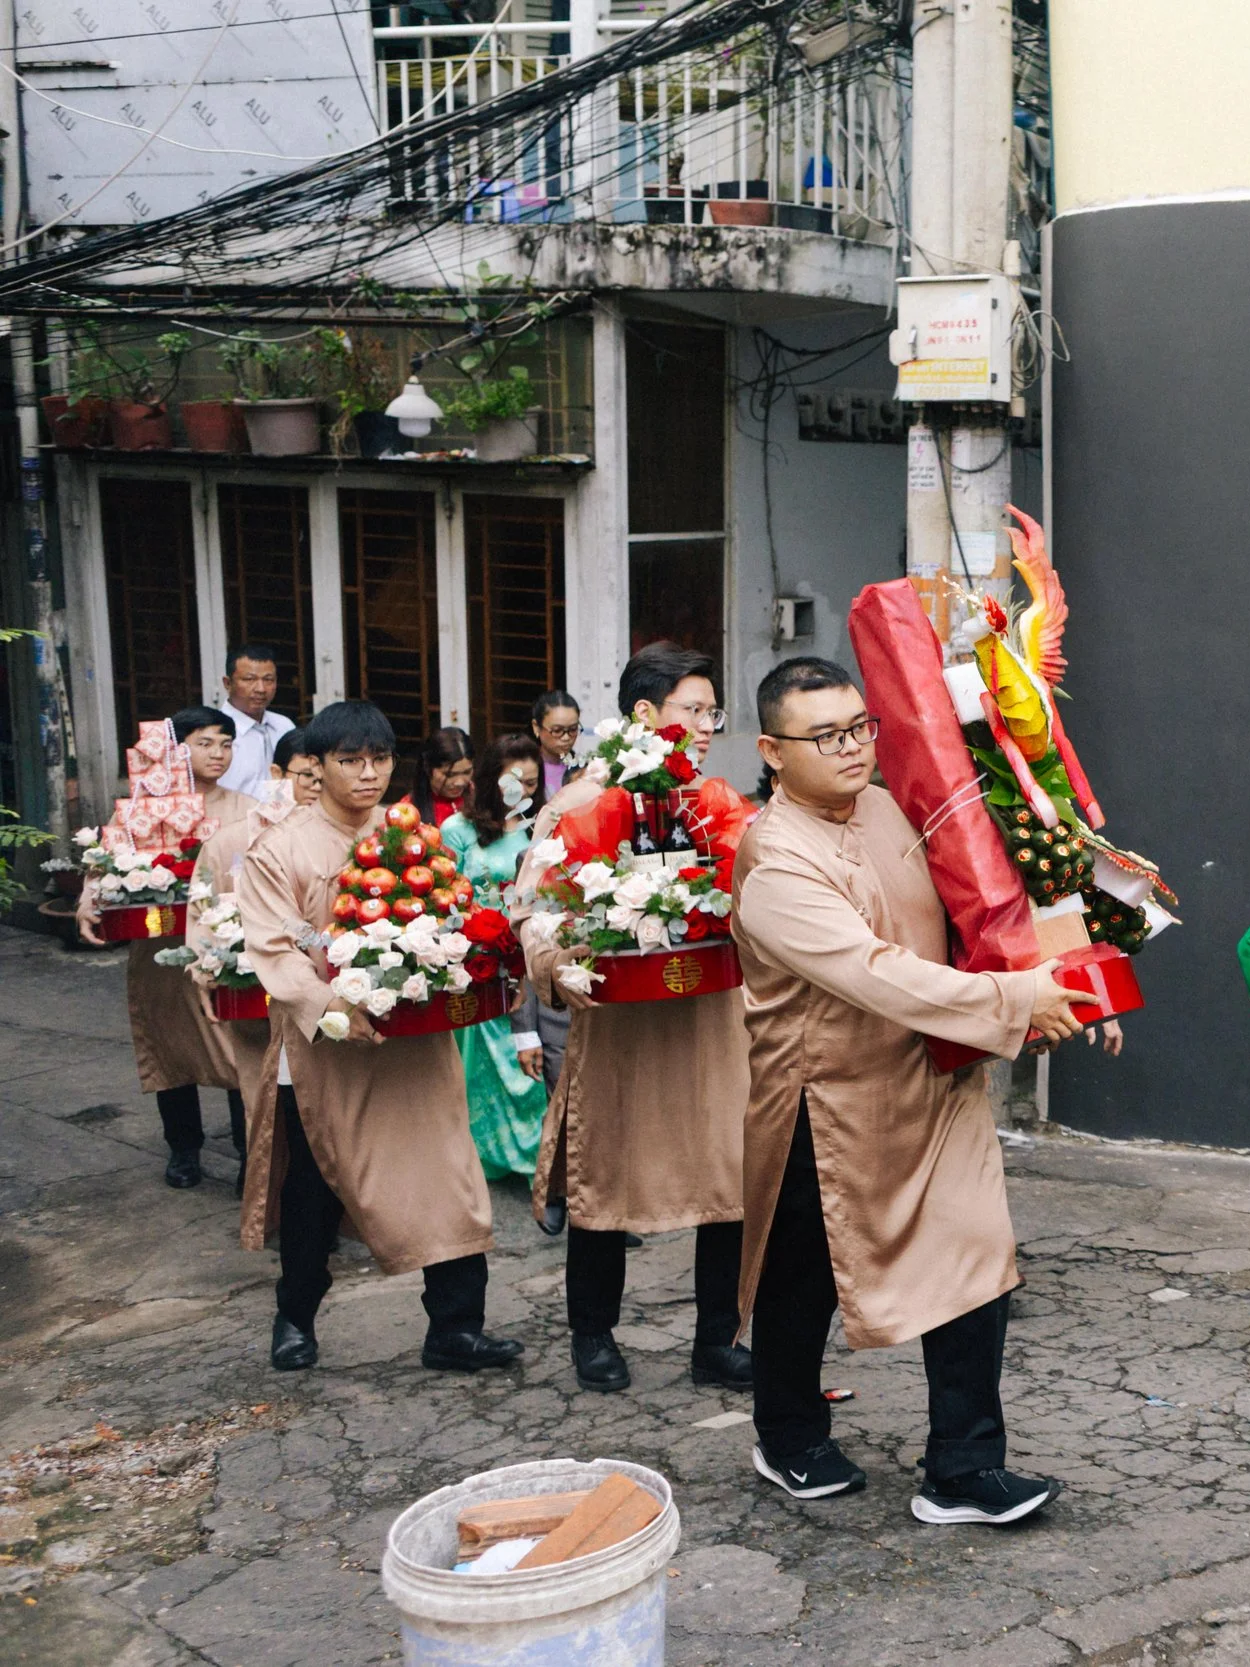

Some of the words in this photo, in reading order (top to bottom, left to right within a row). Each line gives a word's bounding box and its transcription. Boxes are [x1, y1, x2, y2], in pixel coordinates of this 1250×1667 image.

[22, 10, 46, 36] ALU
[73, 7, 100, 34] ALU
[145, 4, 172, 31] ALU
[50, 105, 76, 131] ALU
[120, 103, 146, 128] ALU
[192, 100, 218, 127] ALU
[245, 97, 272, 125] ALU
[317, 95, 344, 123] ALU
[125, 191, 152, 217] ALU
